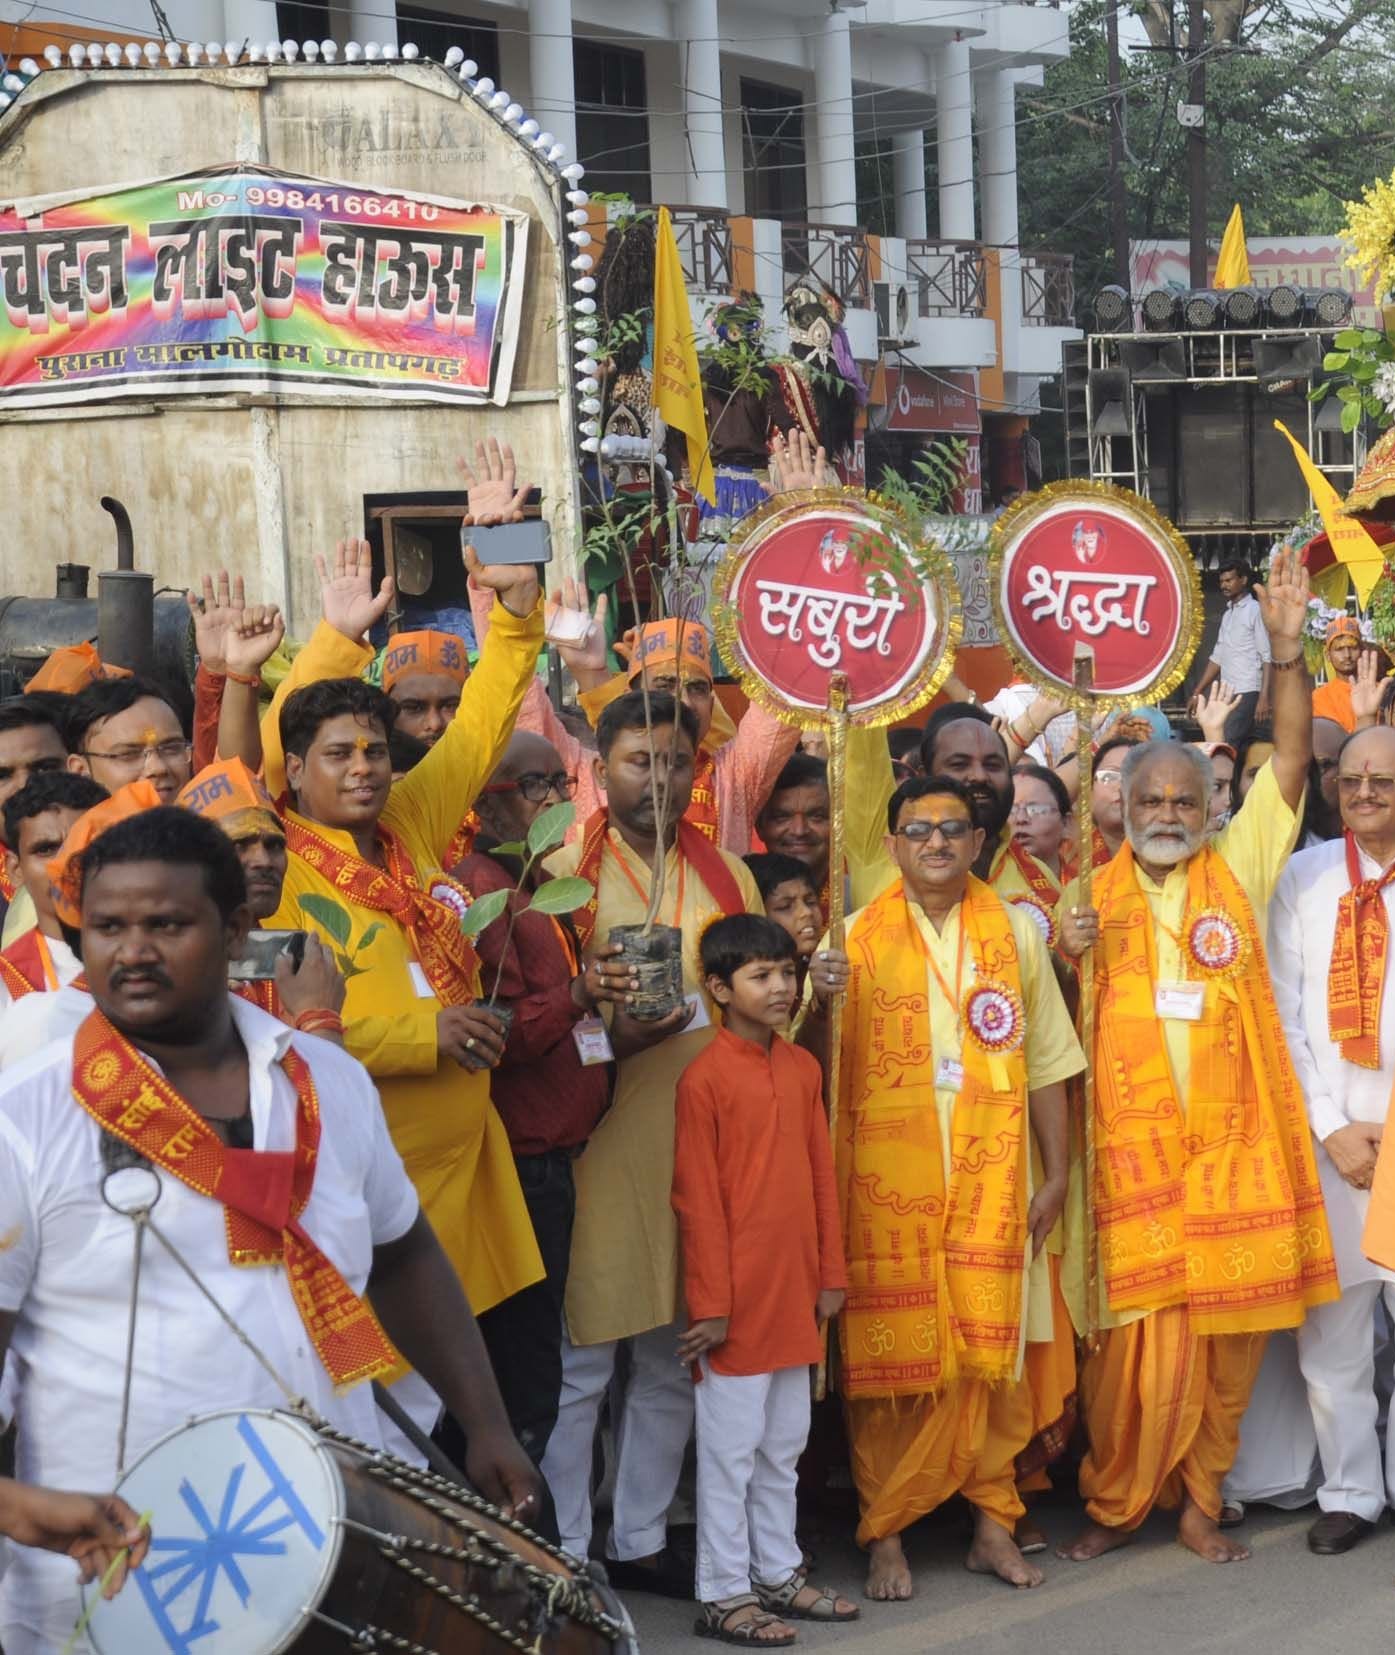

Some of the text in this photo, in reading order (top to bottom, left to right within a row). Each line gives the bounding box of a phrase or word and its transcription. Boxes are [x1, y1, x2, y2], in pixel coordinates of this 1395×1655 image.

[246, 187, 439, 221] 9984166410
[149, 215, 304, 330] लाइट
[319, 219, 486, 335] हाऊस
[36, 346, 127, 381] पुराना
[135, 336, 312, 363] मालगोदाम
[1022, 564, 1158, 636] श्रद्धा
[387, 643, 420, 673] राम
[184, 773, 234, 816] राम
